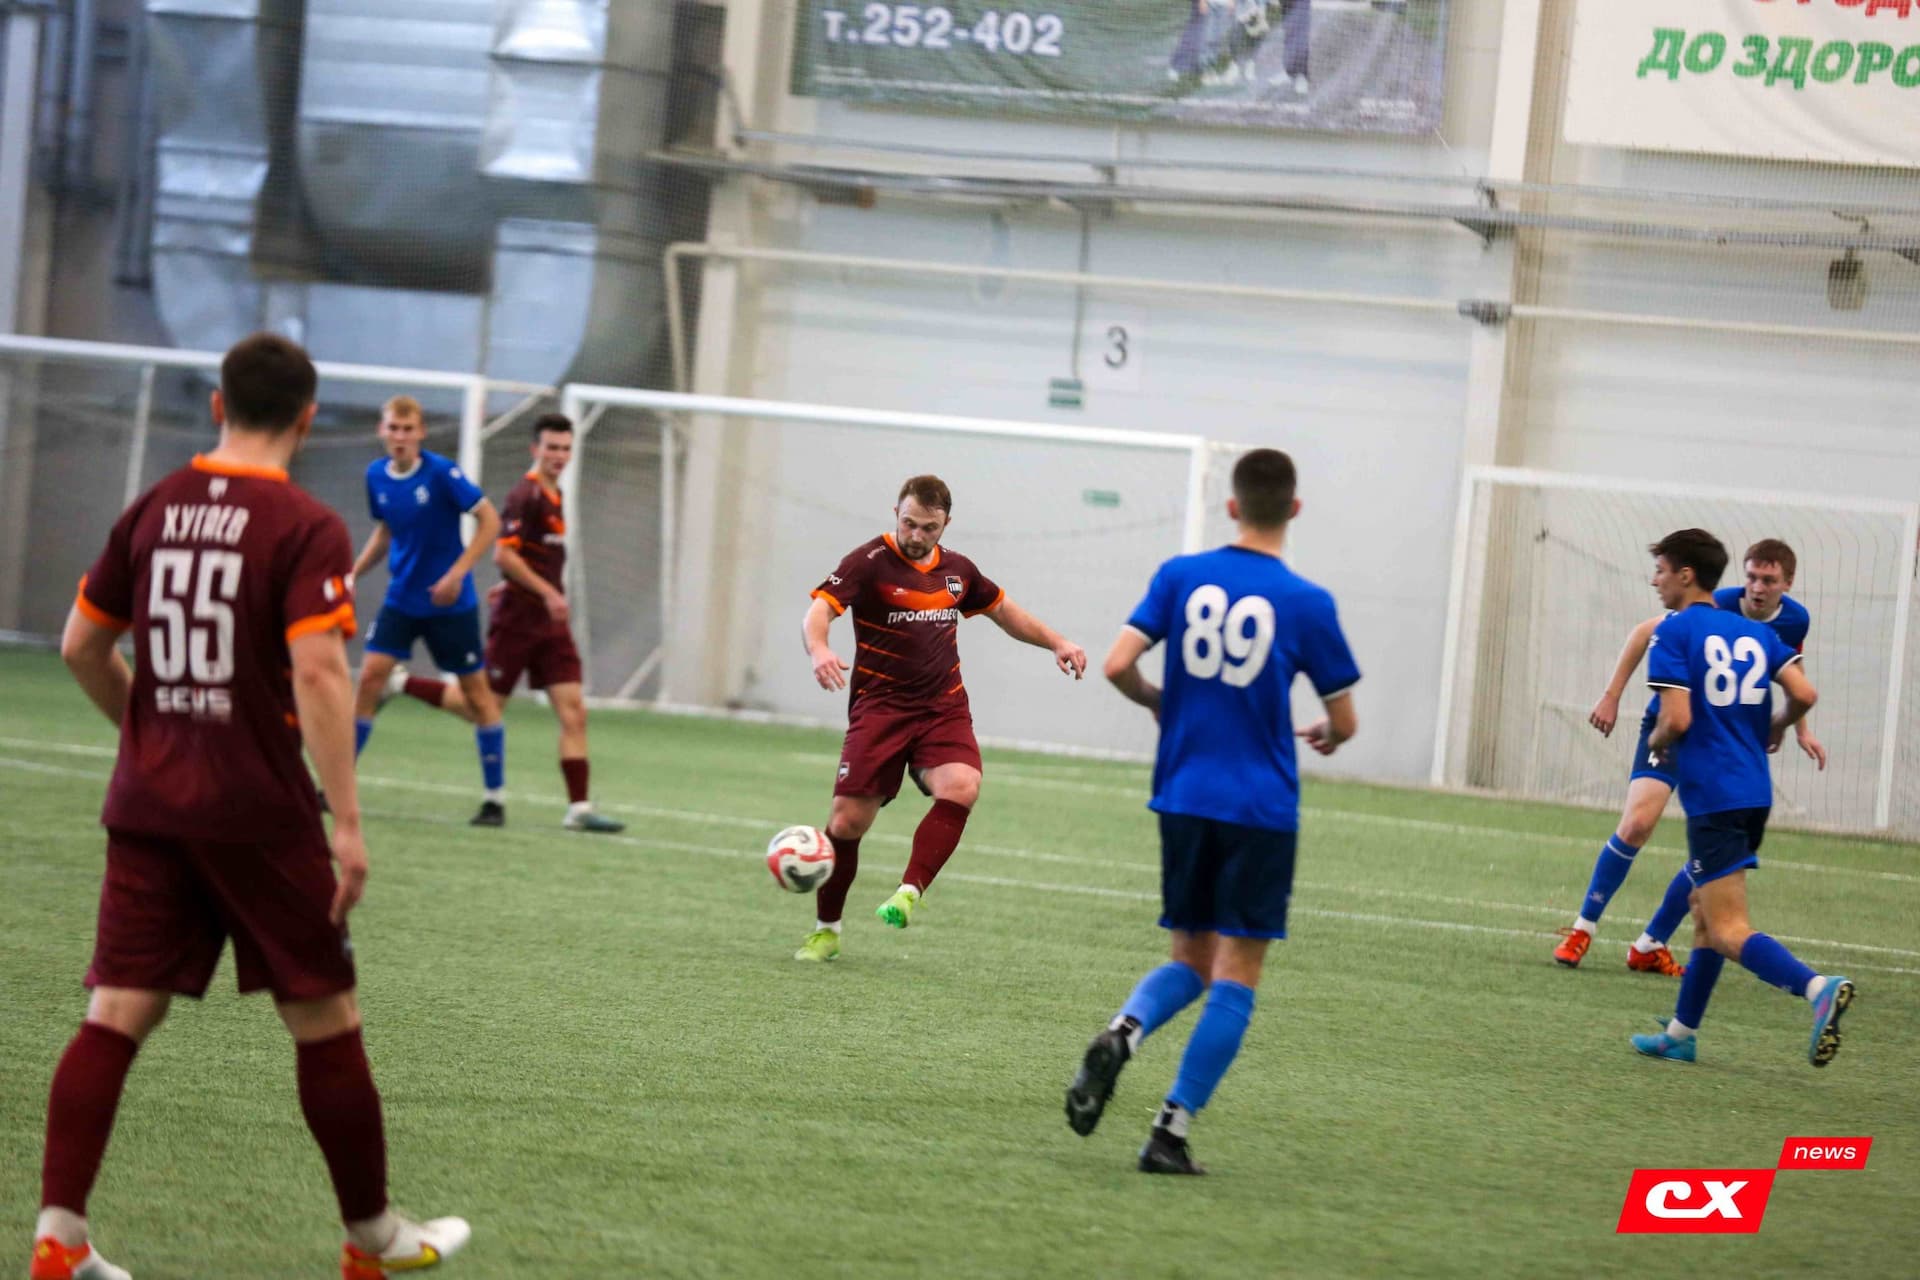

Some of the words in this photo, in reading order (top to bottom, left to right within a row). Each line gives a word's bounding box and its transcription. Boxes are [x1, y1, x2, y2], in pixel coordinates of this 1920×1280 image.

[1636, 27, 1727, 81] ДО
[1732, 34, 1920, 90] ЗДОРО
[1104, 325, 1128, 370] 3
[148, 547, 243, 684] 55
[1182, 583, 1276, 688] 89
[1704, 635, 1769, 708] 82
